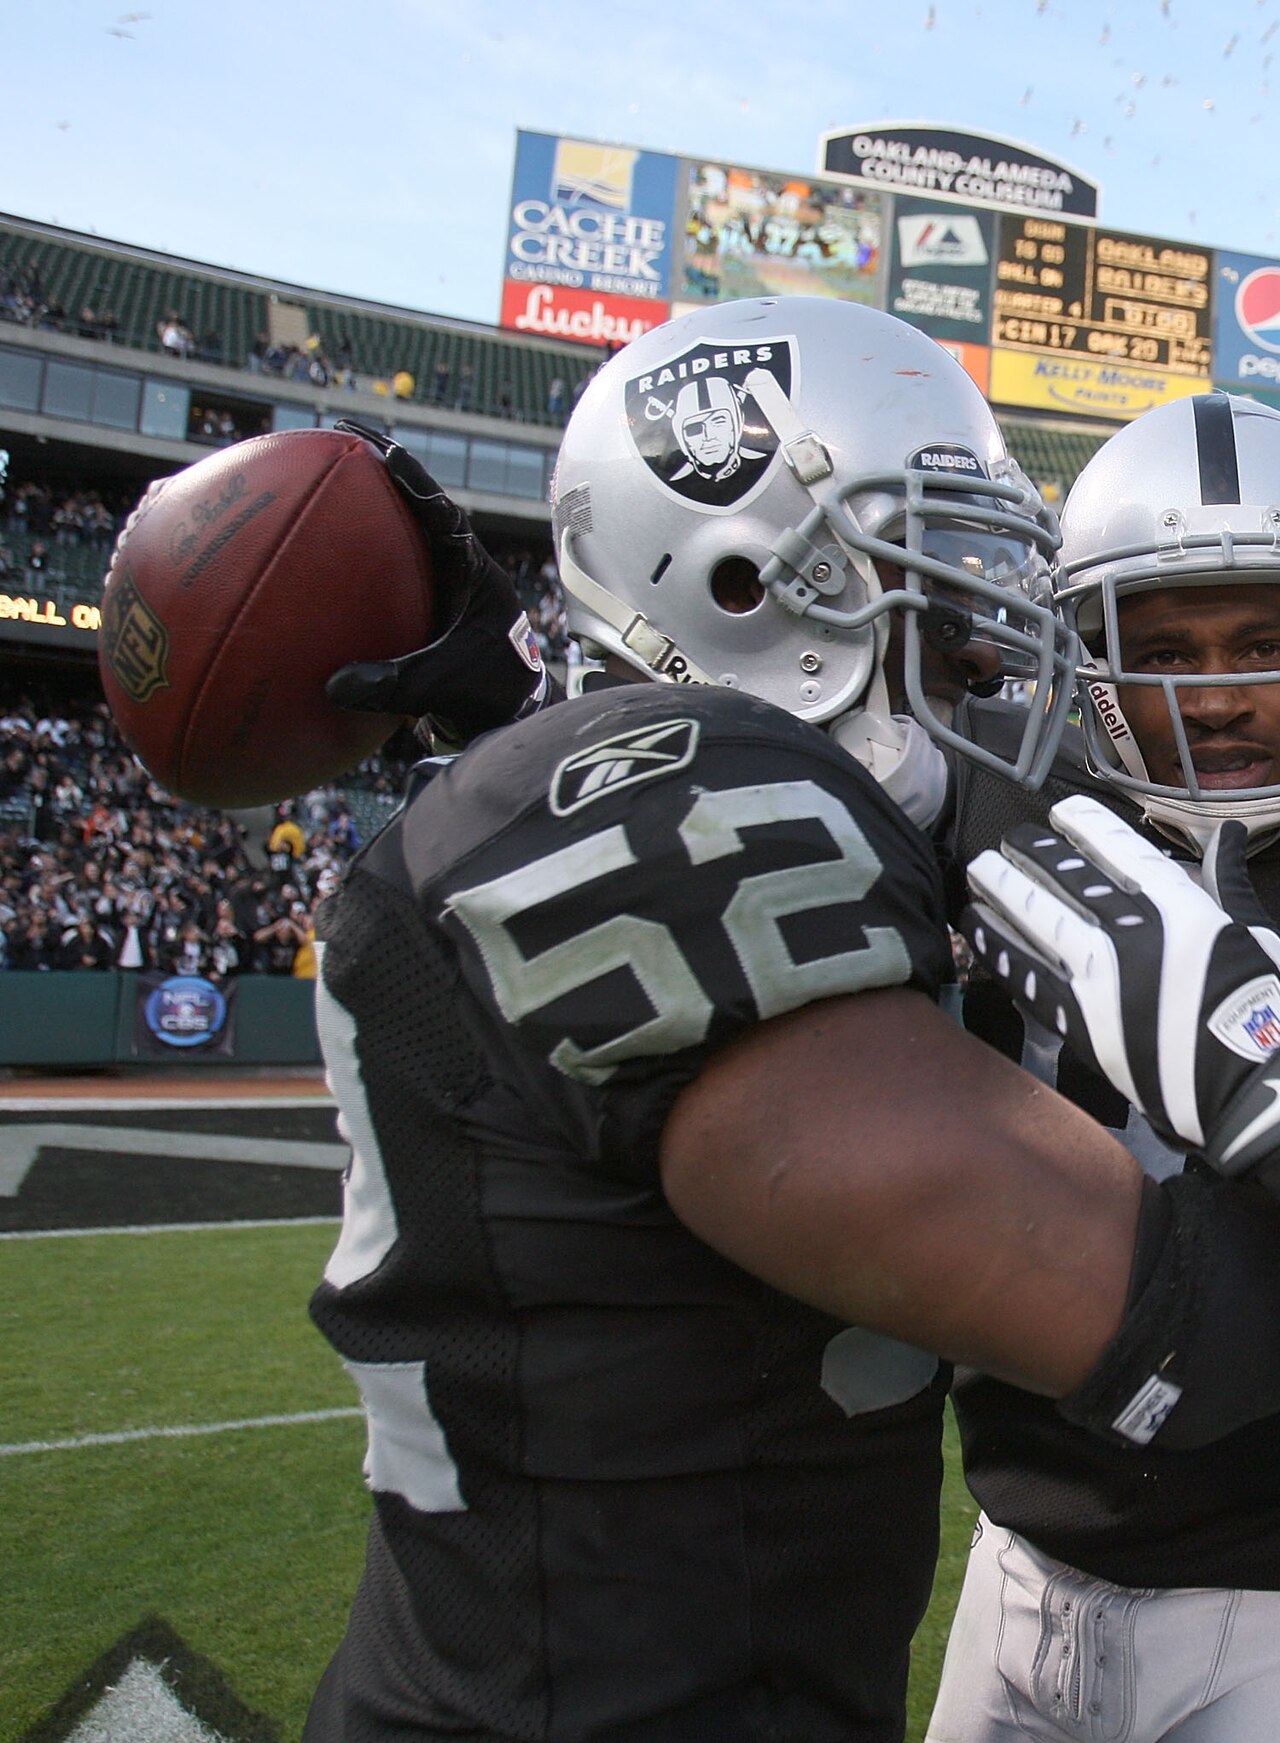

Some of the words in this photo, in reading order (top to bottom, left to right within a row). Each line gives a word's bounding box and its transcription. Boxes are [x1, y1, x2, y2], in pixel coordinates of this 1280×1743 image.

[852, 135, 1073, 194] OAKLAND-ALAMEDA
[861, 157, 954, 191] COUNTY
[955, 174, 1064, 211] COLISEUM
[513, 200, 666, 251] CACHE
[511, 231, 662, 281] CREEK
[1097, 238, 1208, 272] OAKLAND
[1097, 267, 1208, 302] RAIDERS
[515, 285, 645, 343] Lucky
[1005, 319, 1047, 344] CIN
[1050, 323, 1077, 348] 17
[1087, 331, 1129, 356] OAK
[1130, 337, 1159, 361] 20
[639, 346, 773, 394] RAIDERS
[921, 453, 976, 471] RAIDERS
[113, 612, 158, 693] NFL
[450, 779, 912, 1086] 52
